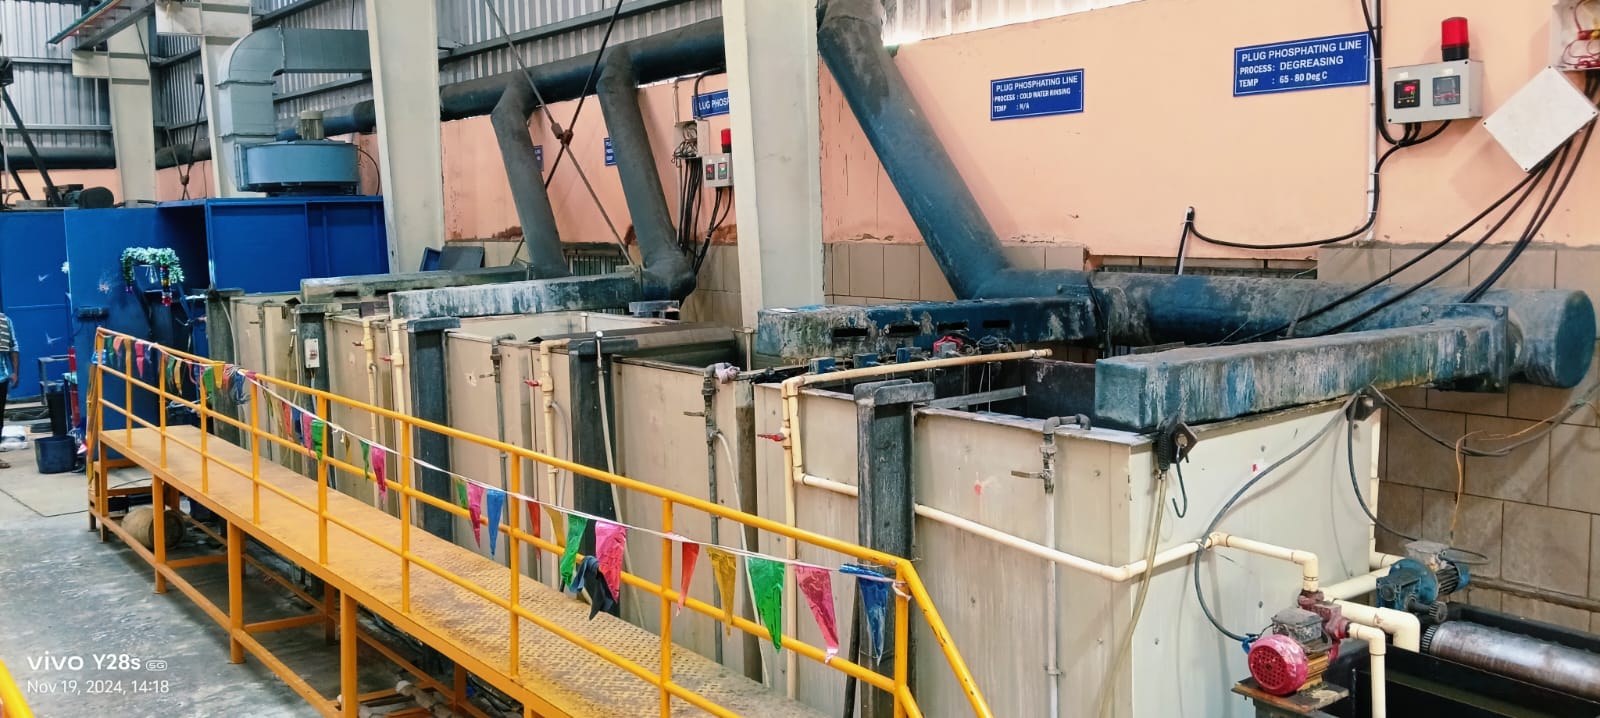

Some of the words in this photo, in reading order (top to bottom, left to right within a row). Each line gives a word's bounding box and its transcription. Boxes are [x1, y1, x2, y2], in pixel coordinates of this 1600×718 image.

[1242, 51, 1266, 63] PLUG
[1269, 43, 1336, 59] PHOSPHATING
[1339, 40, 1362, 51] LINE
[1280, 56, 1344, 70] DEGREASING
[996, 84, 1013, 92] PLUG
[1015, 78, 1060, 90] PHOSPHATING
[1062, 76, 1078, 84] LINE
[1239, 79, 1259, 87] TEMP
[1280, 75, 1289, 83] 65
[1295, 74, 1305, 82] 80
[1306, 72, 1321, 81] Deg
[1322, 71, 1328, 79] C
[1033, 90, 1049, 98] WATER
[1050, 88, 1071, 96] RINSING
[994, 104, 1007, 112] TEMP
[1020, 102, 1030, 110] N/A
